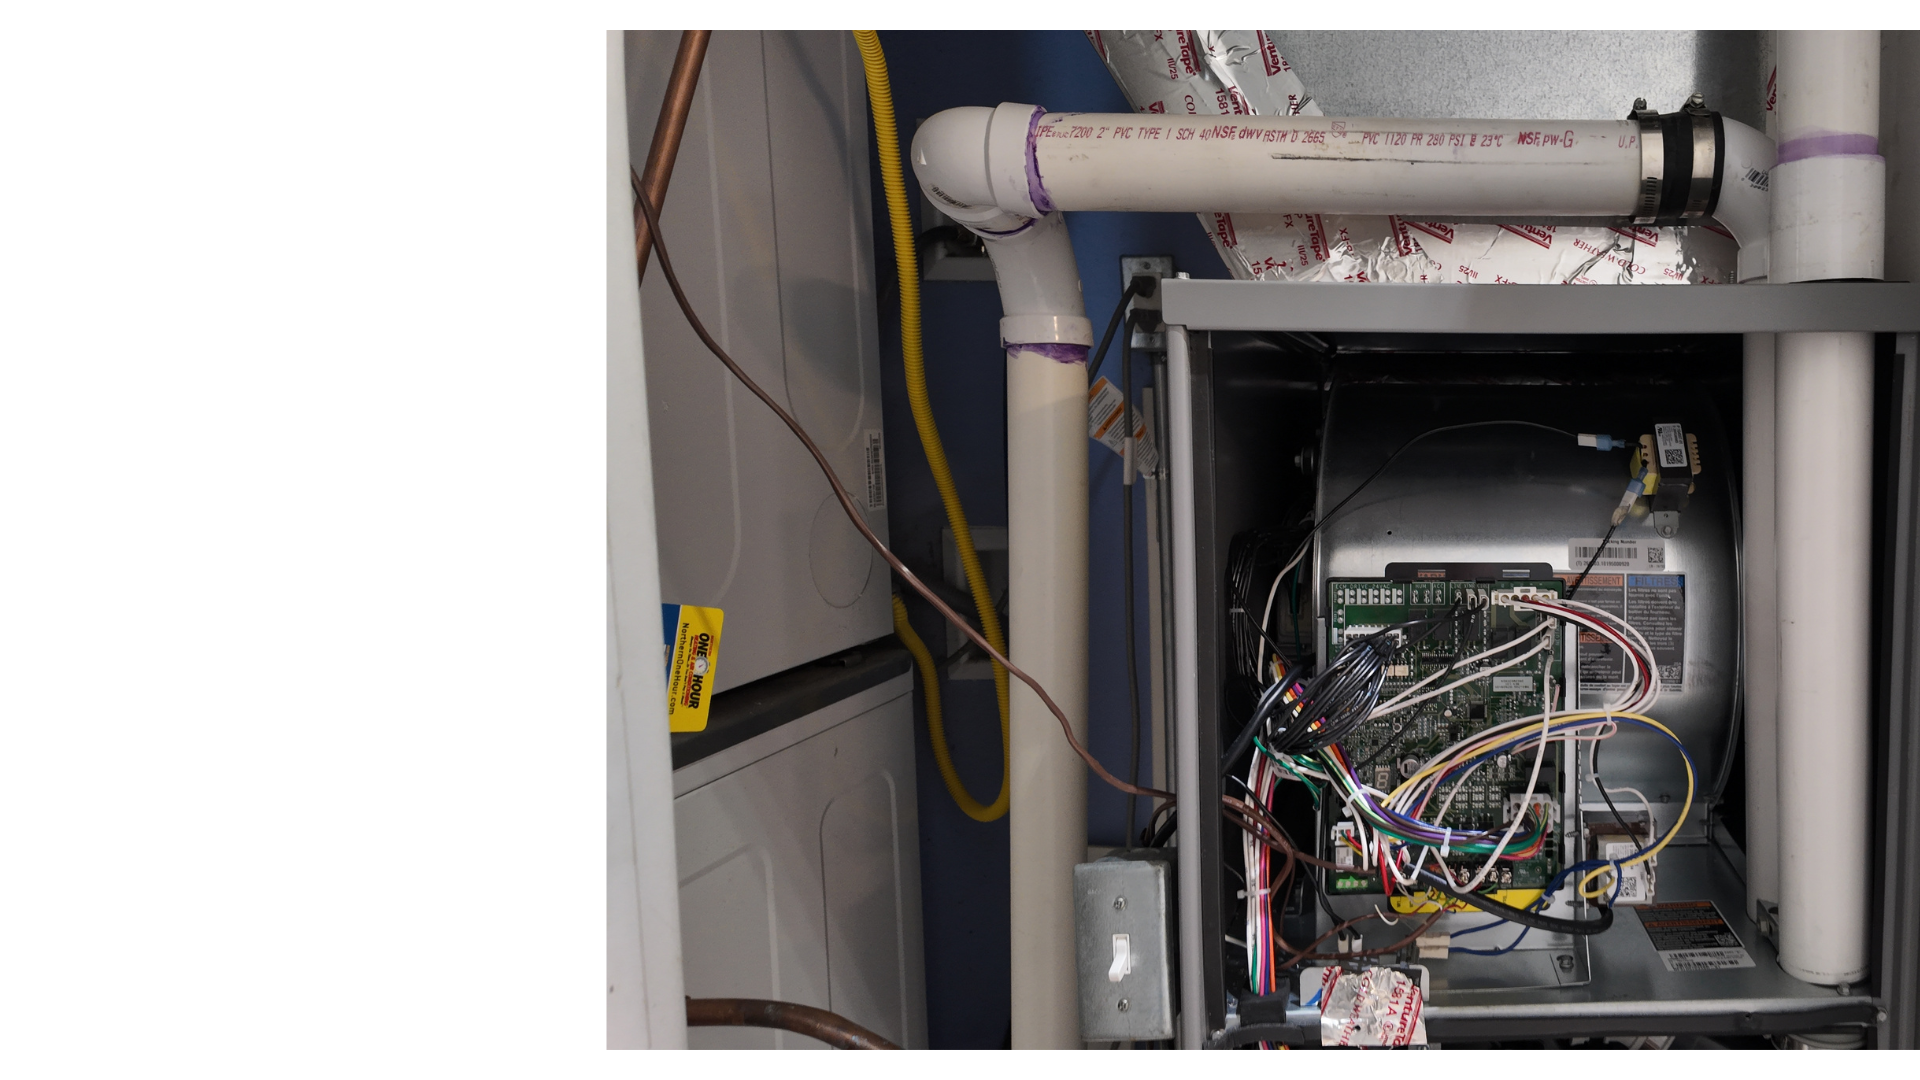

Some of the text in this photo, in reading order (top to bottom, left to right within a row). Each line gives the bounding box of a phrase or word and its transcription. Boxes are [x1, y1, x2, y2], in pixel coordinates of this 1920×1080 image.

[1113, 127, 1134, 139] PVC
[1138, 127, 1163, 140] TYPE
[1176, 128, 1196, 141] SCH
[1302, 131, 1326, 144] 2665
[1361, 132, 1381, 146] PVC
[1410, 133, 1424, 147] PR
[1427, 133, 1445, 147] 280
[1448, 134, 1466, 147] PSI
[1635, 577, 1678, 587] FILTRES
[669, 622, 690, 715] NorthernOneHour.com
[688, 632, 710, 709] ONE HOUR
